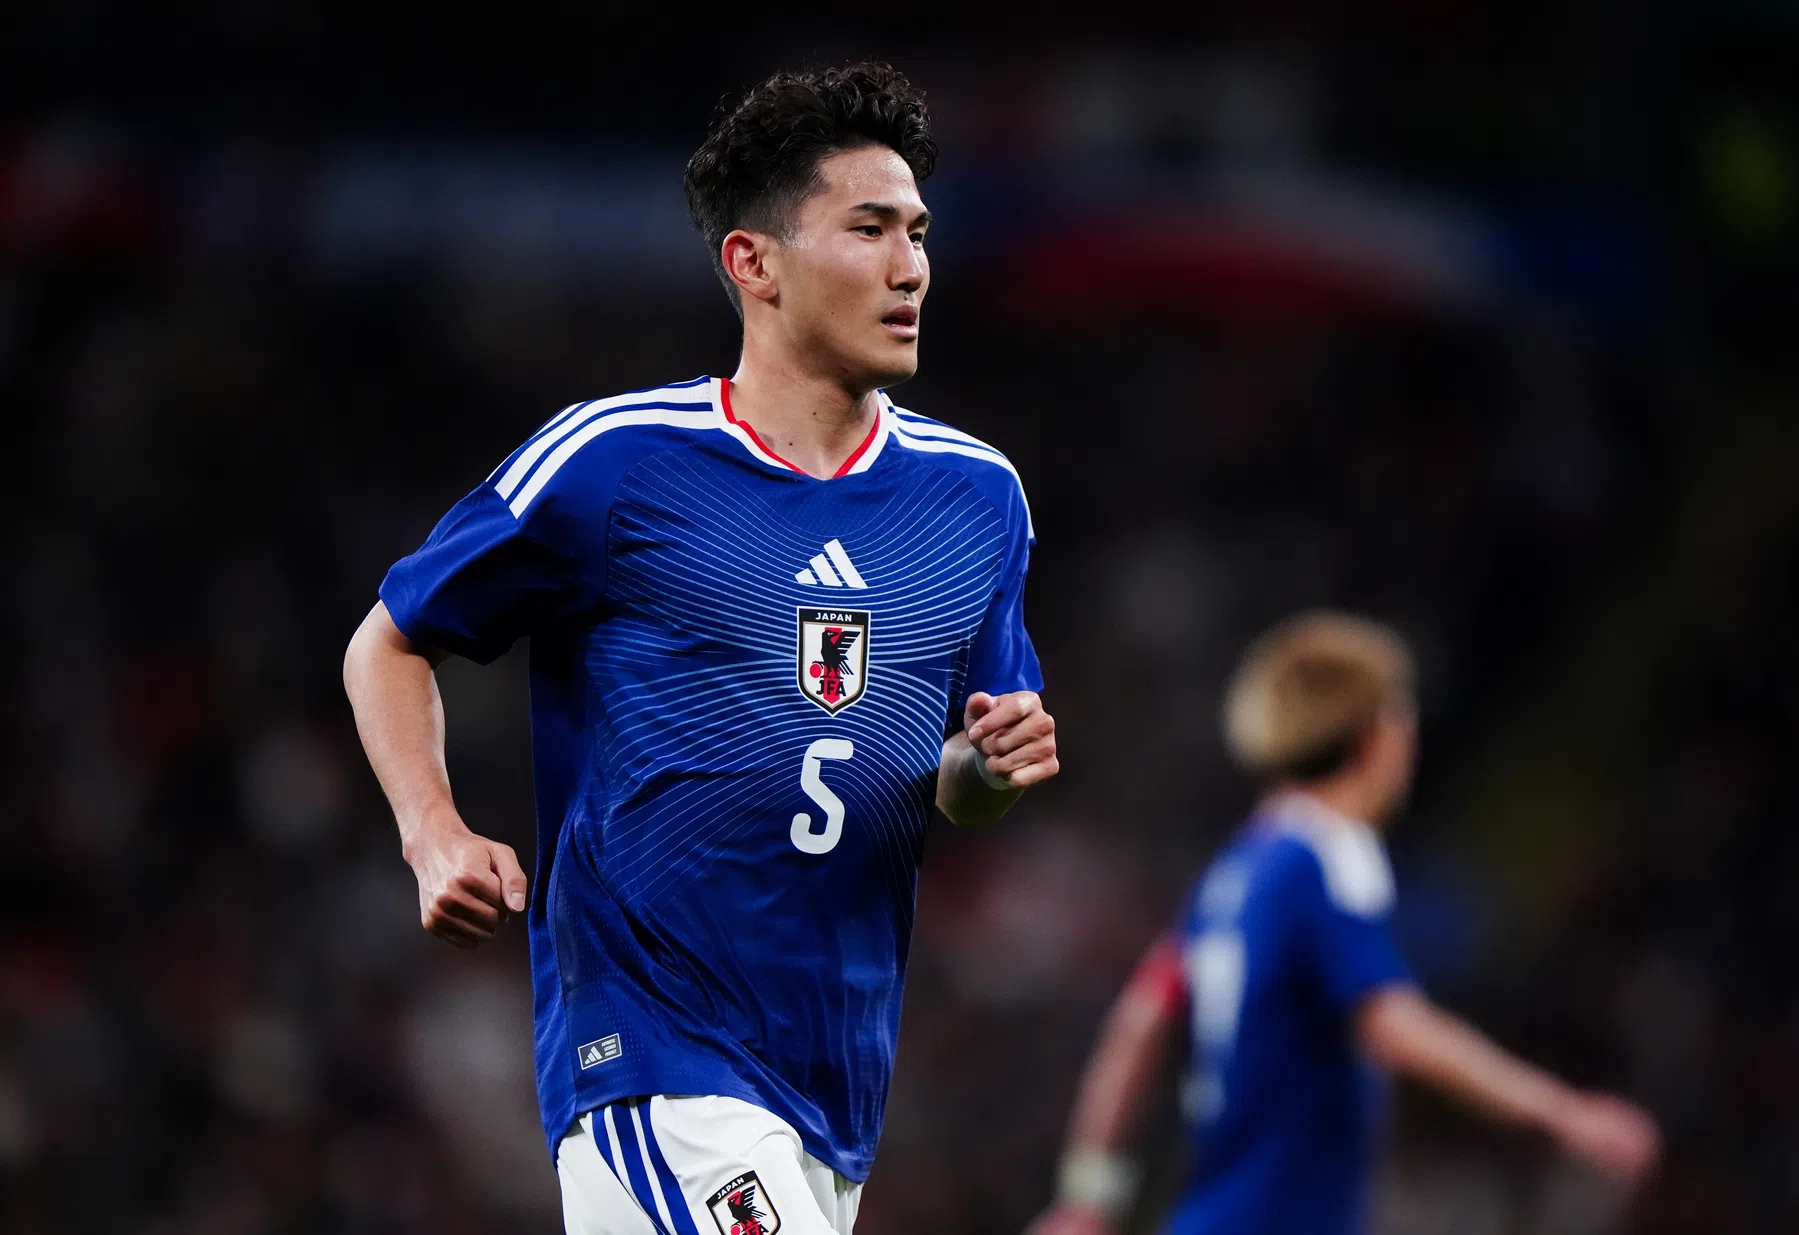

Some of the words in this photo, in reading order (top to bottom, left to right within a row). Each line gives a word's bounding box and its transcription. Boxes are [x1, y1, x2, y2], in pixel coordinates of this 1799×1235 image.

[815, 612, 852, 622] JAPAN
[816, 680, 847, 697] JFA
[790, 738, 854, 854] 5
[717, 1177, 745, 1200] JAPAN
